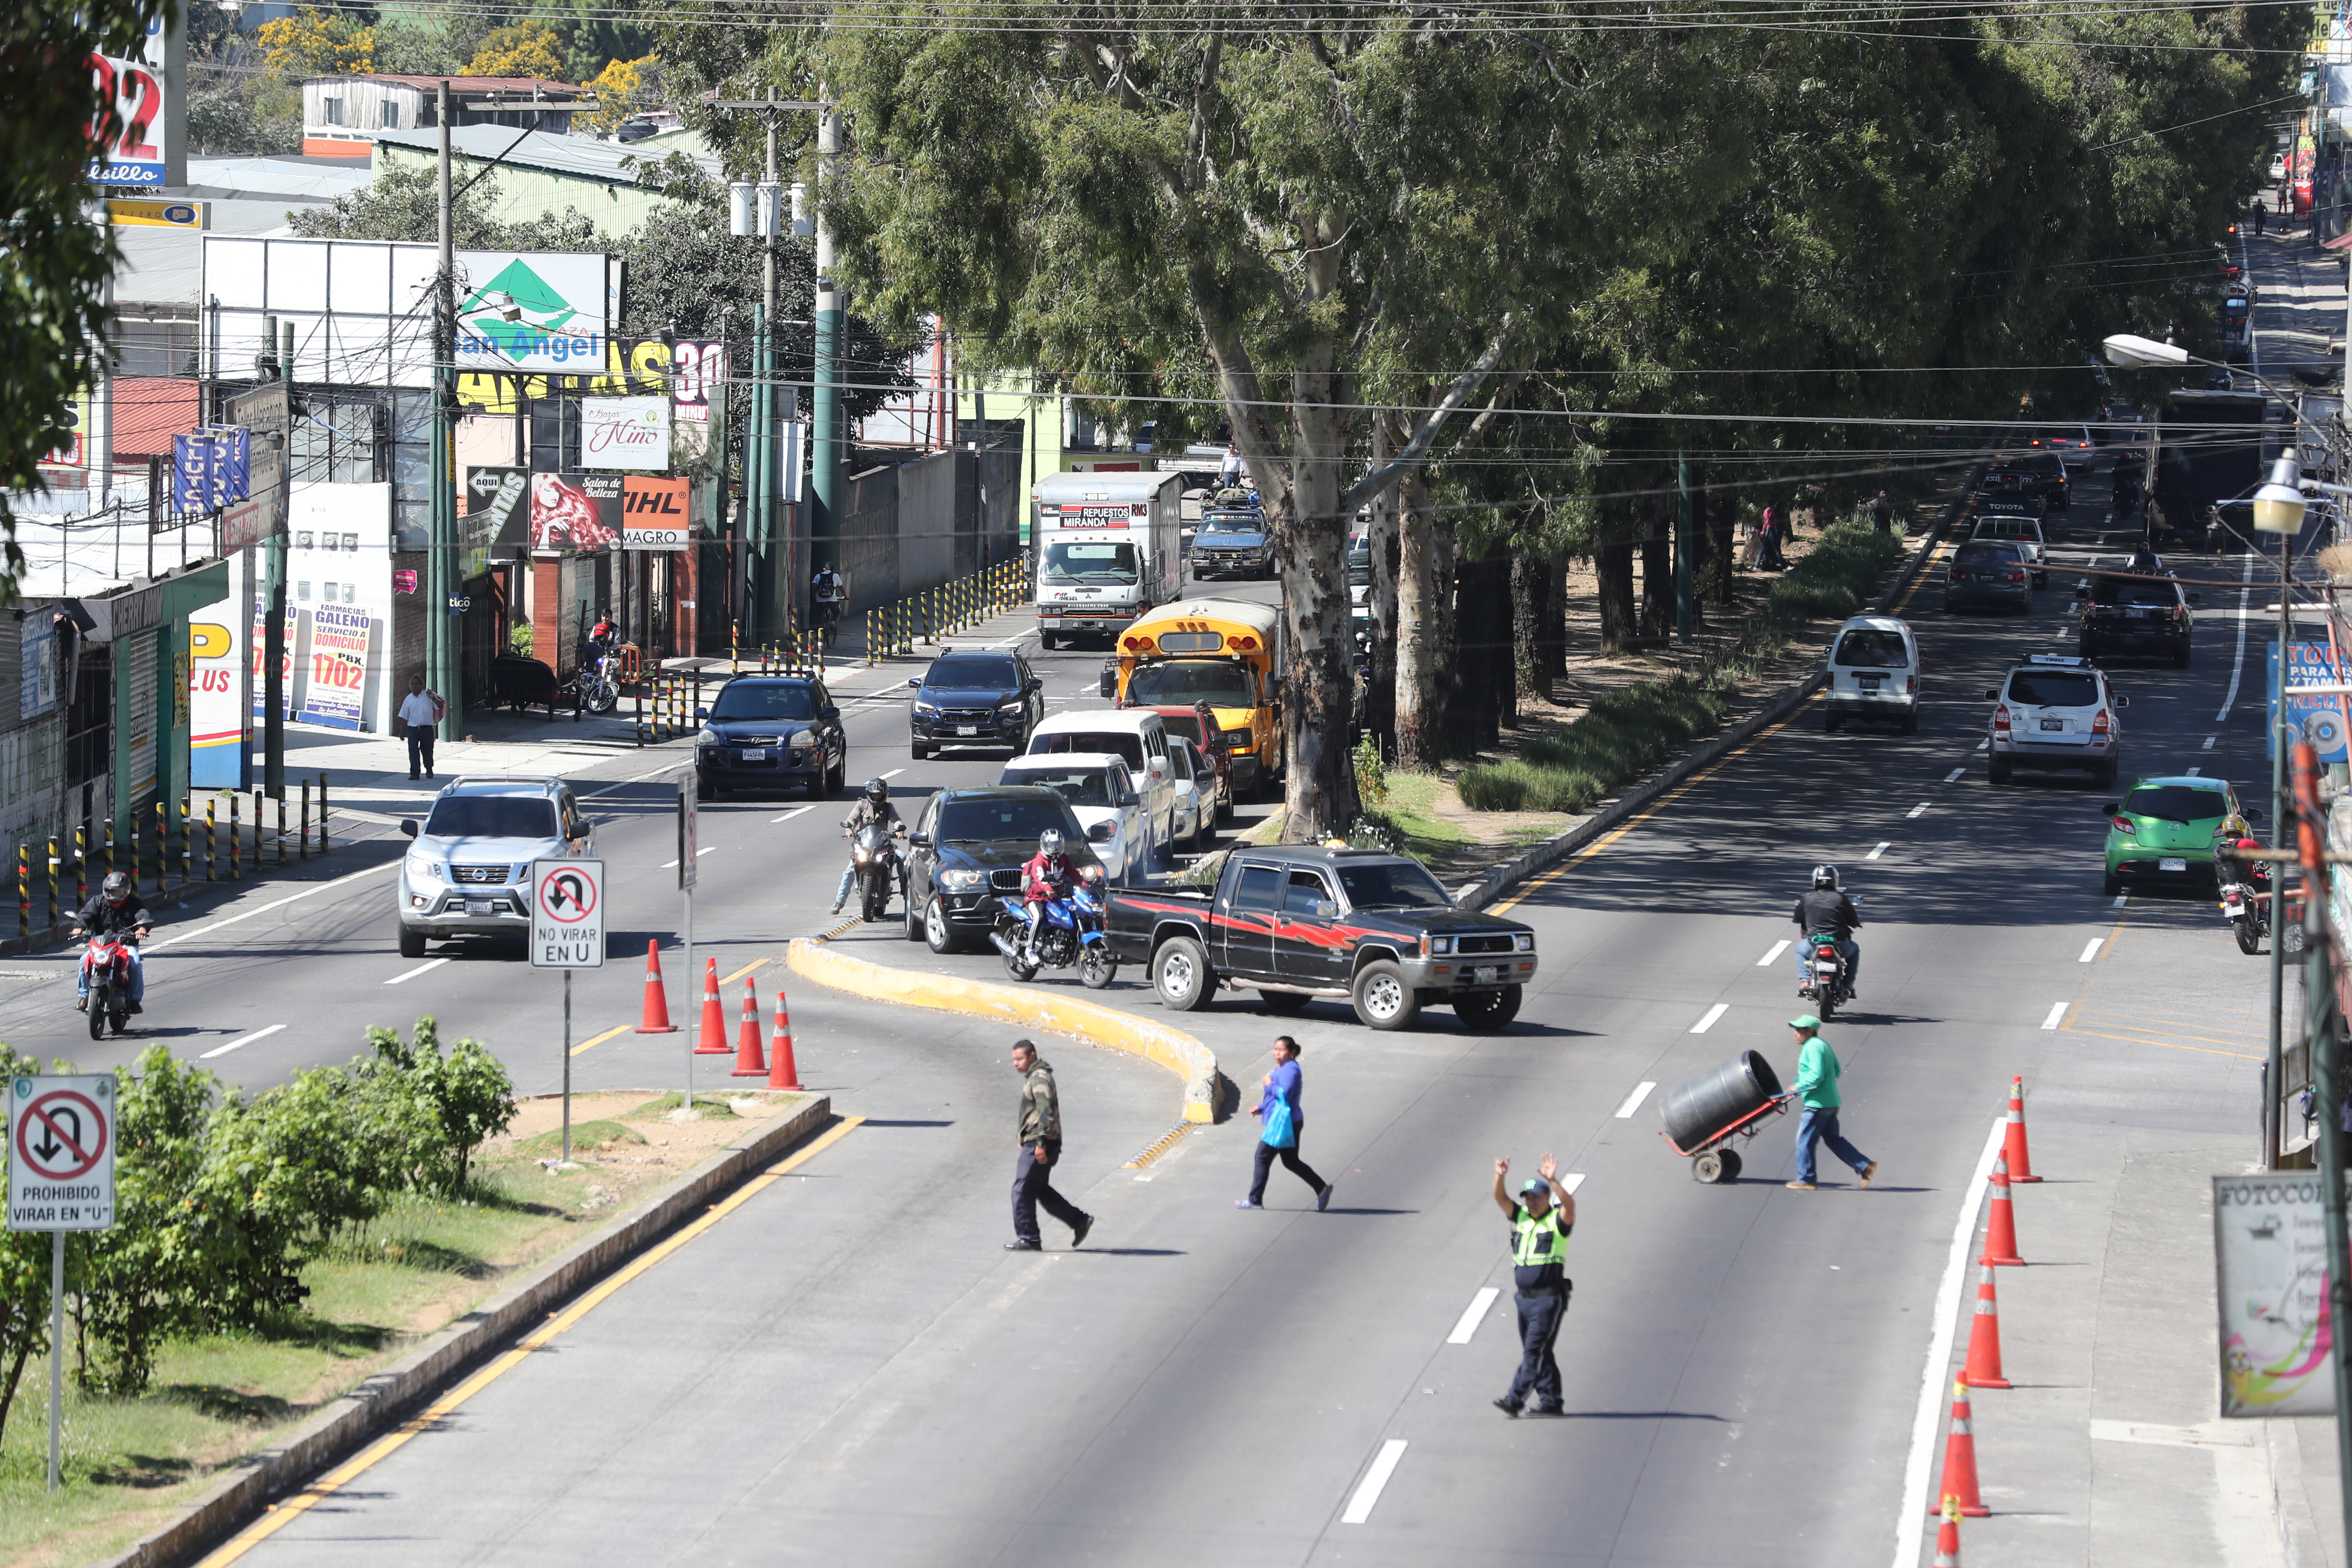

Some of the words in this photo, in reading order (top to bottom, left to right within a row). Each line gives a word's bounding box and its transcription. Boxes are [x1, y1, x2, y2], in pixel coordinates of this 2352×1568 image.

[110, 210, 161, 219] CAJERO
[536, 325, 589, 336] PLAZA
[509, 331, 597, 362] Angel
[588, 408, 621, 422] Bazar
[589, 419, 658, 453] Niño
[184, 435, 205, 514] CLUTCH
[476, 478, 497, 487] AQUI
[582, 477, 608, 488] Salon
[609, 478, 622, 488] de
[585, 487, 619, 498] Belleza
[1083, 508, 1129, 517] REPUESTOS
[1131, 503, 1148, 517] RM3
[1064, 518, 1107, 527] MIRANDA
[449, 597, 471, 607] tigo
[113, 592, 144, 637] CHERRY
[321, 604, 366, 616] FARMACIAS
[315, 611, 370, 628] GALENO
[316, 625, 358, 637] SERVICIO
[315, 633, 366, 652] DOMICILIO
[338, 652, 364, 667] PBX.
[312, 652, 363, 690] 1702
[2290, 666, 2328, 677] PARA
[326, 707, 349, 716] bolsillo
[337, 701, 360, 711] también
[539, 928, 555, 941] NO
[560, 928, 596, 941] VIRAR
[546, 946, 569, 962] EN
[575, 943, 588, 962] U
[23, 1186, 100, 1200] PROHIBIDO
[14, 1207, 55, 1222] VIRAR
[61, 1207, 79, 1221] EN
